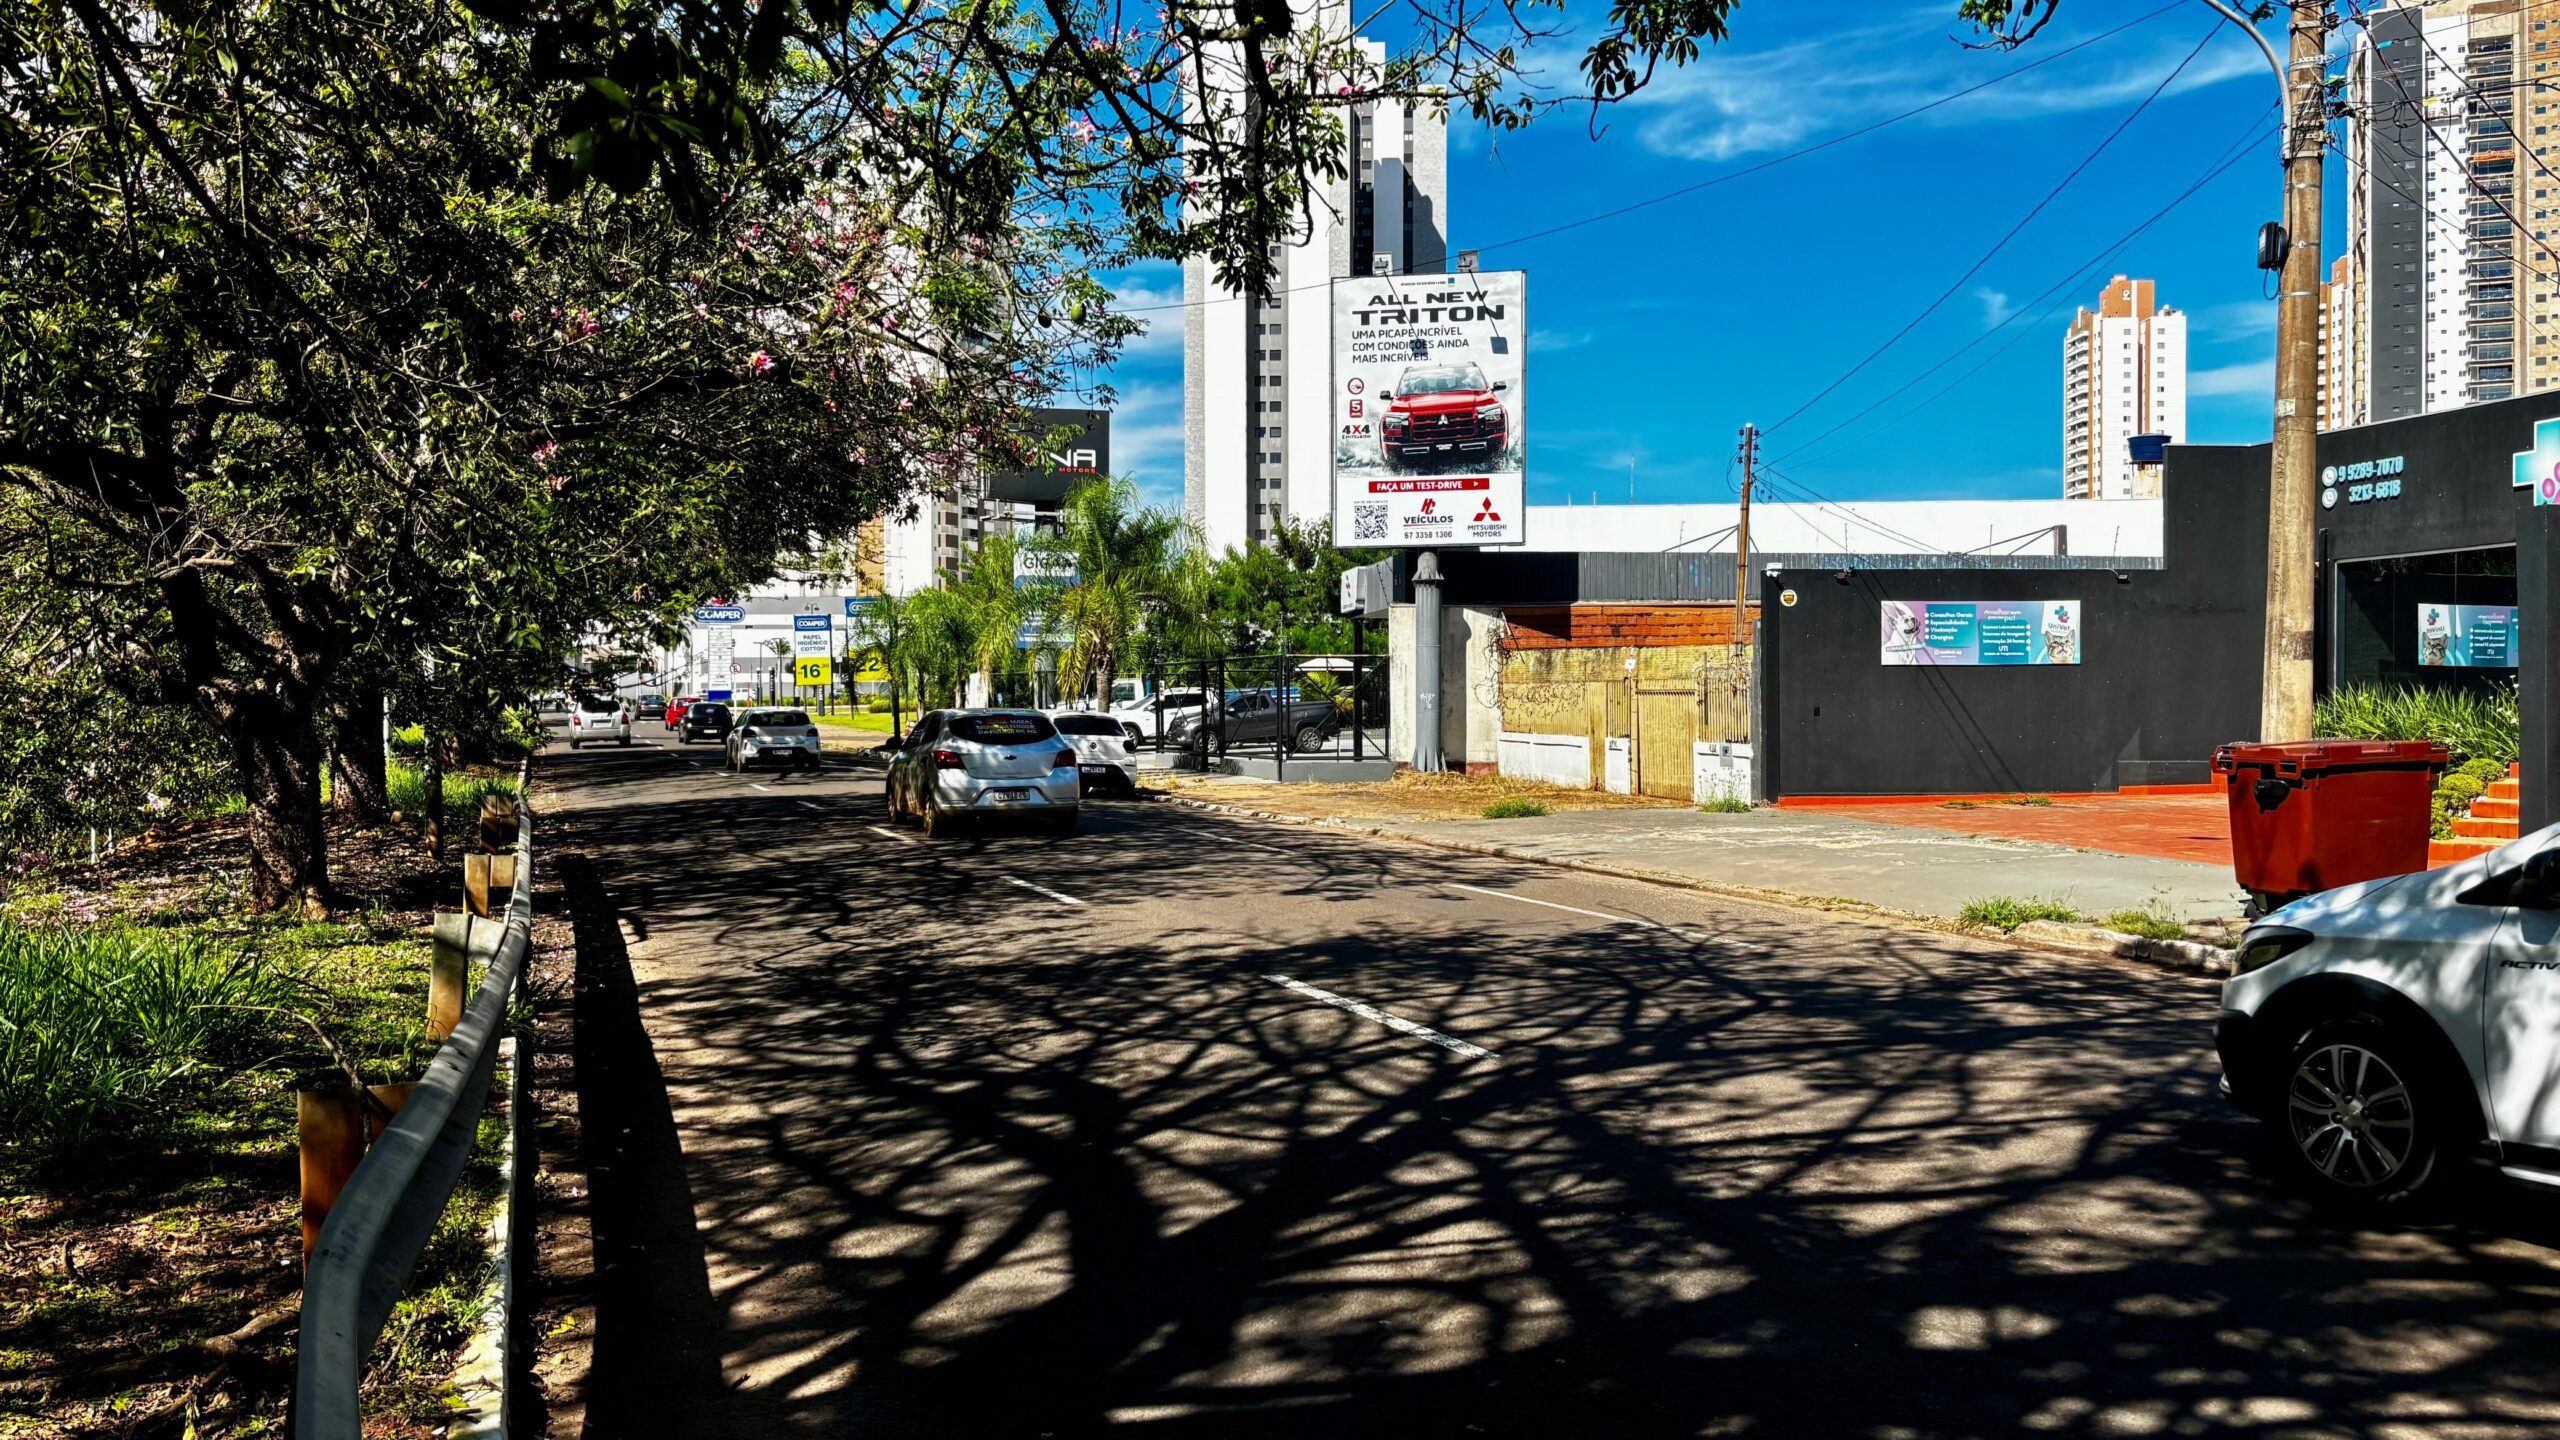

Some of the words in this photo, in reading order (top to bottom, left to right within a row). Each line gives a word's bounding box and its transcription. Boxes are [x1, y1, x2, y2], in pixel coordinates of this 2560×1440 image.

[1368, 294, 1418, 306] ALL
[1426, 290, 1489, 304] NEW
[1352, 304, 1505, 326] TRITON
[1352, 330, 1376, 340] UMA
[1378, 328, 1414, 339] PICAPE
[1416, 325, 1463, 337] INCRÍVEL
[1352, 342, 1376, 352] COM
[1377, 339, 1435, 351] CONDIÇÕES
[1436, 338, 1470, 349] AINDA
[1352, 353, 1378, 364] MAIS
[1351, 400, 1361, 411] 5
[2338, 466, 2347, 482] 9
[1376, 482, 1398, 493] FAÇA
[1400, 482, 1414, 491] UM
[1416, 481, 1463, 490] TEST-DRIVE
[2348, 479, 2401, 502] 3213-6818
[1403, 514, 1454, 525] VEÍCULOS
[1404, 531, 1414, 539] 67
[1415, 531, 1433, 539] 3358
[1435, 530, 1453, 539] 1300
[697, 610, 741, 619] COMPER
